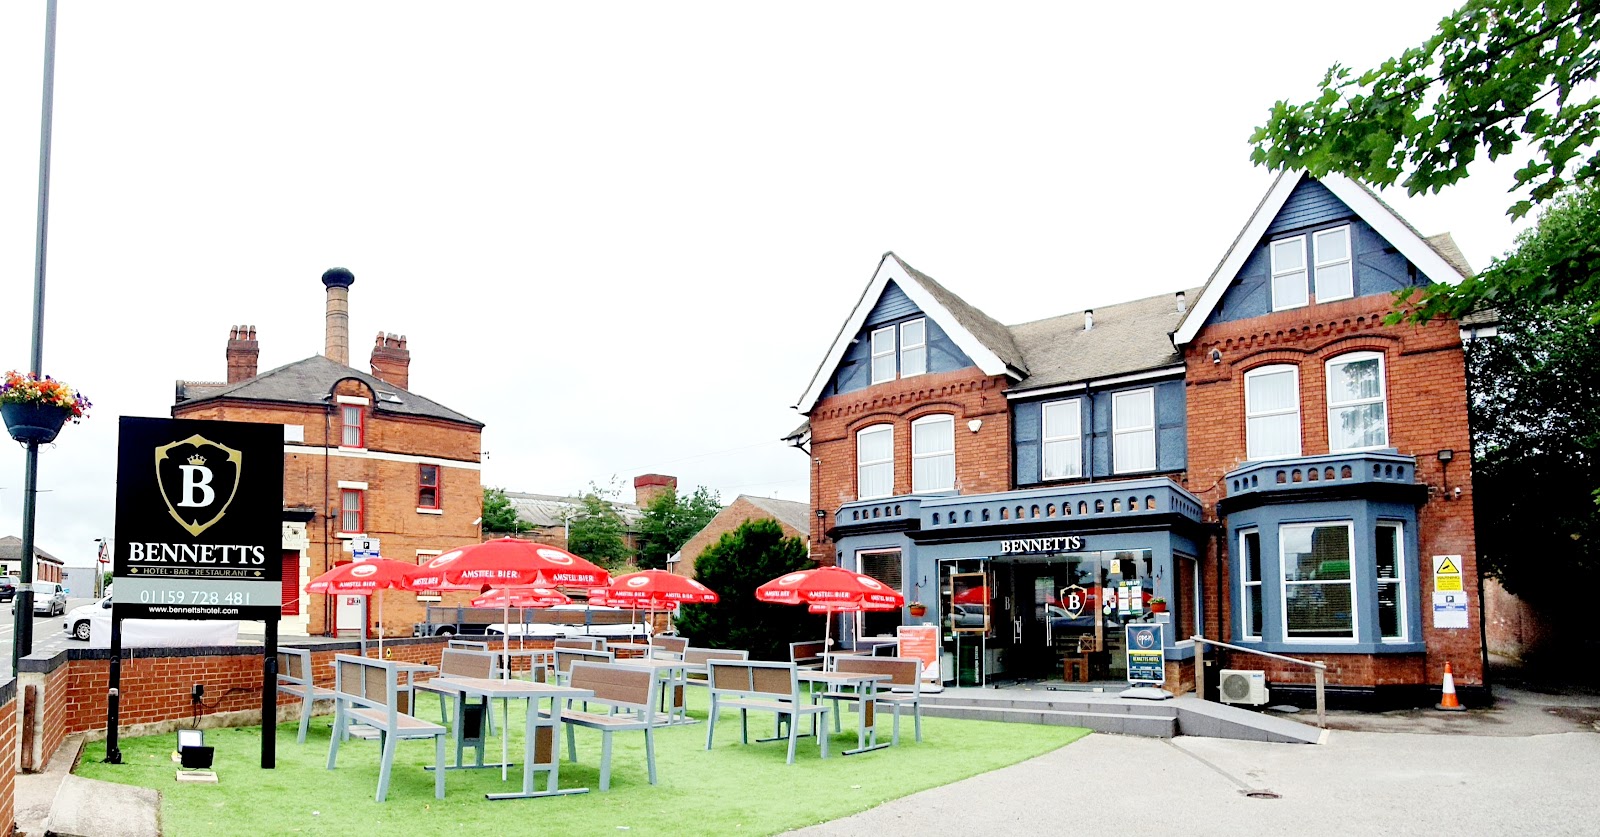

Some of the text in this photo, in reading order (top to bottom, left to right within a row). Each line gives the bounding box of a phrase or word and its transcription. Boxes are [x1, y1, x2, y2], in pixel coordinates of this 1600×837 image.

[177, 465, 215, 507] B
[1001, 536, 1081, 553] BENNETTS
[128, 542, 265, 565] BENNETTS
[195, 569, 248, 577] RESTAURANT
[461, 570, 518, 578] AMSTEL BIER
[553, 573, 577, 582] AMSTEL
[140, 590, 250, 605] 01159 728 481
[1067, 595, 1081, 610] B
[149, 606, 239, 614] www.bennettshotel.com
[1138, 634, 1152, 646] open
